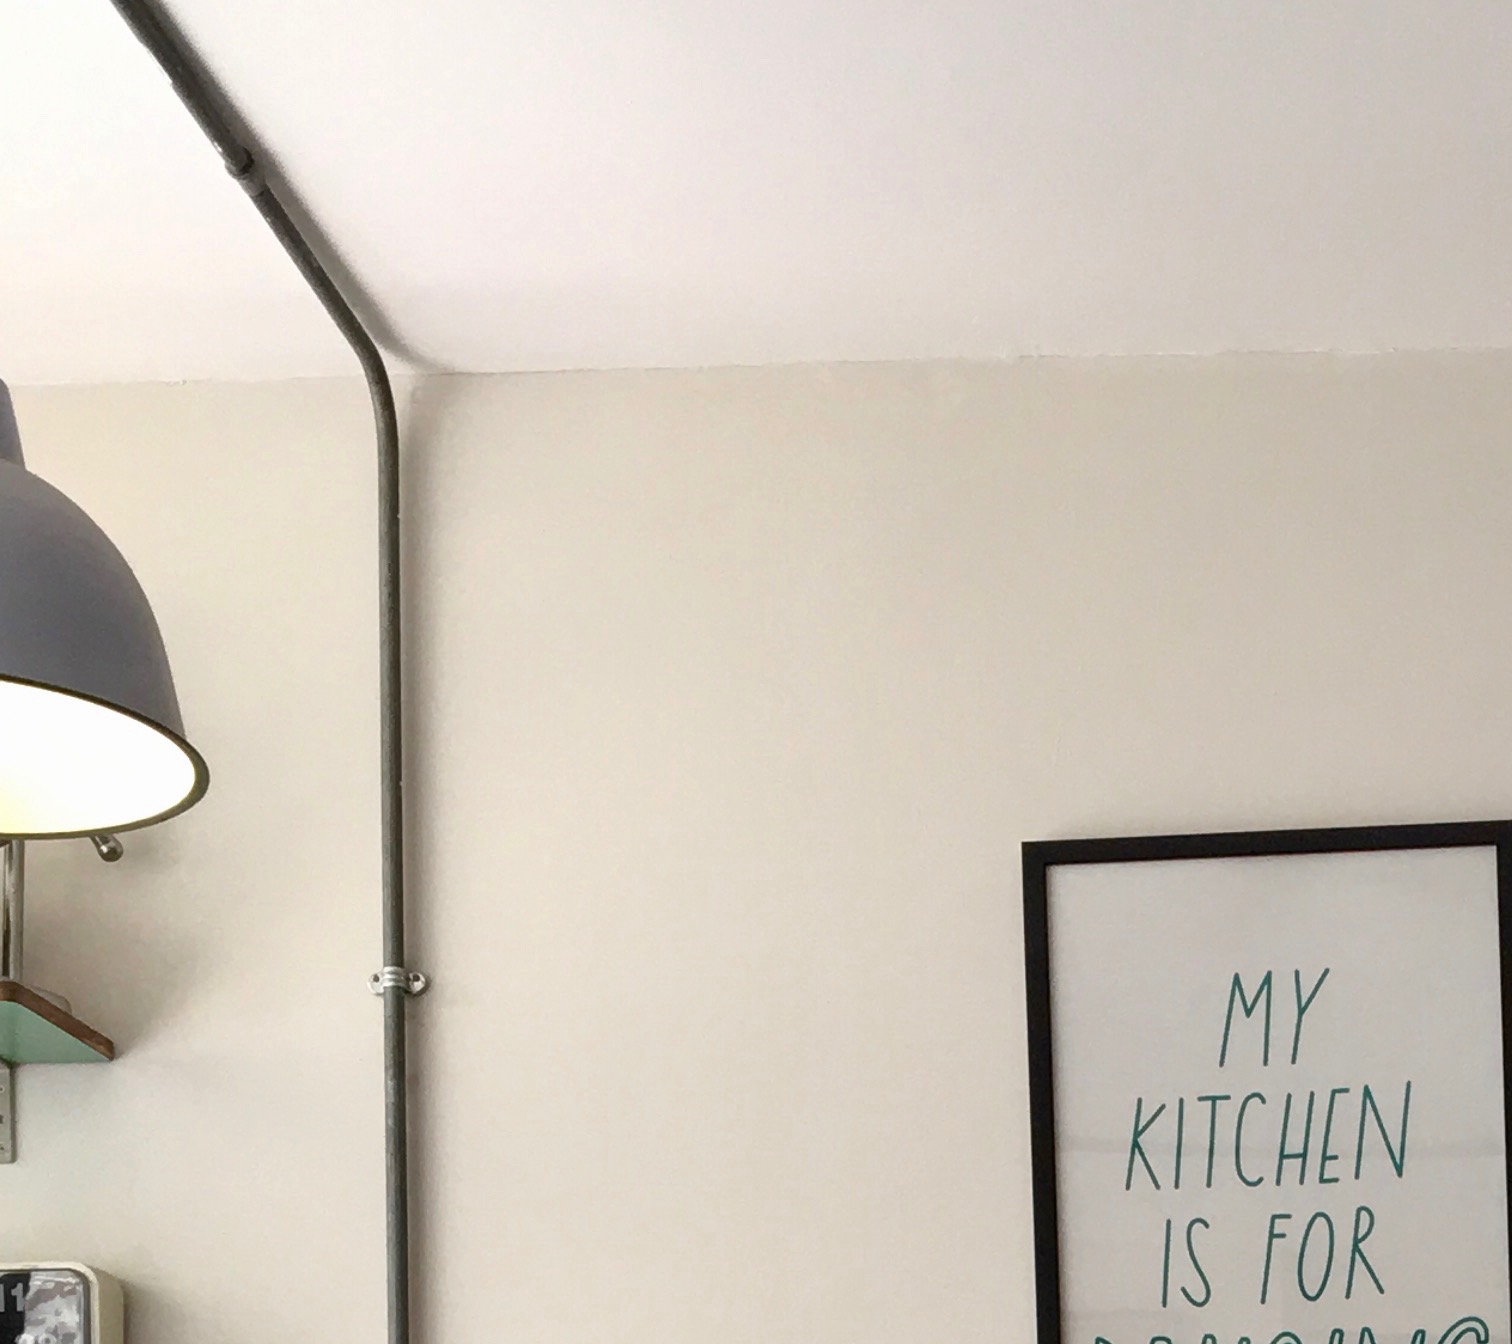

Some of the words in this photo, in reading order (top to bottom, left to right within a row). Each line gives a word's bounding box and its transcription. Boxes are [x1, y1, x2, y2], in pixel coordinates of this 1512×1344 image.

[1219, 967, 1330, 1068] MY
[1125, 1080, 1412, 1191] KITCHEN
[1162, 1217, 1212, 1308] IS
[1259, 1206, 1385, 1305] FOR
